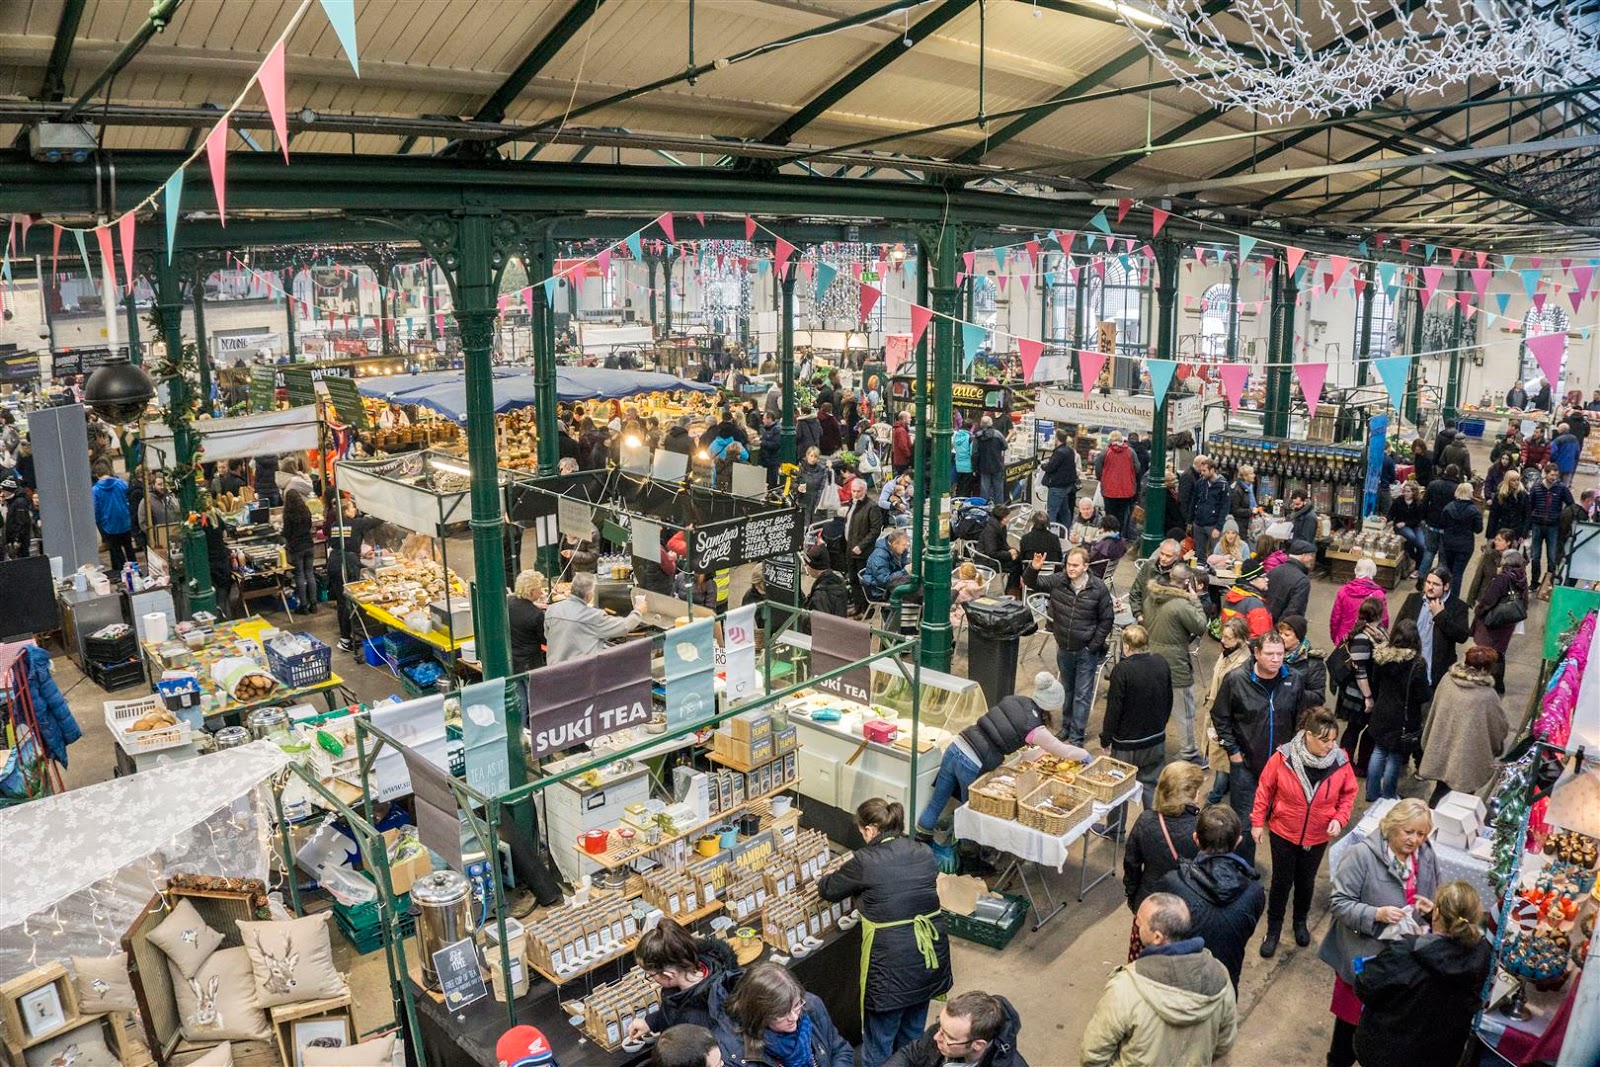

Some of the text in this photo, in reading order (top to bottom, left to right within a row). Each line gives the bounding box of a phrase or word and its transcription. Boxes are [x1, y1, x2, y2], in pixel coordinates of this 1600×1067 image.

[1058, 398, 1100, 411] Conaill's
[1102, 401, 1152, 418] Chocolate
[745, 514, 793, 531] BELFAST BAPS
[745, 521, 795, 539] STEAK BURGERS
[745, 530, 787, 545] STEAK SUBS
[745, 536, 792, 552] FILLED SODAS
[699, 540, 732, 569] Grill
[744, 548, 770, 559] ULSTER
[844, 684, 868, 700] TEA
[599, 702, 648, 729] TEA
[736, 841, 772, 868] BAMBOO
